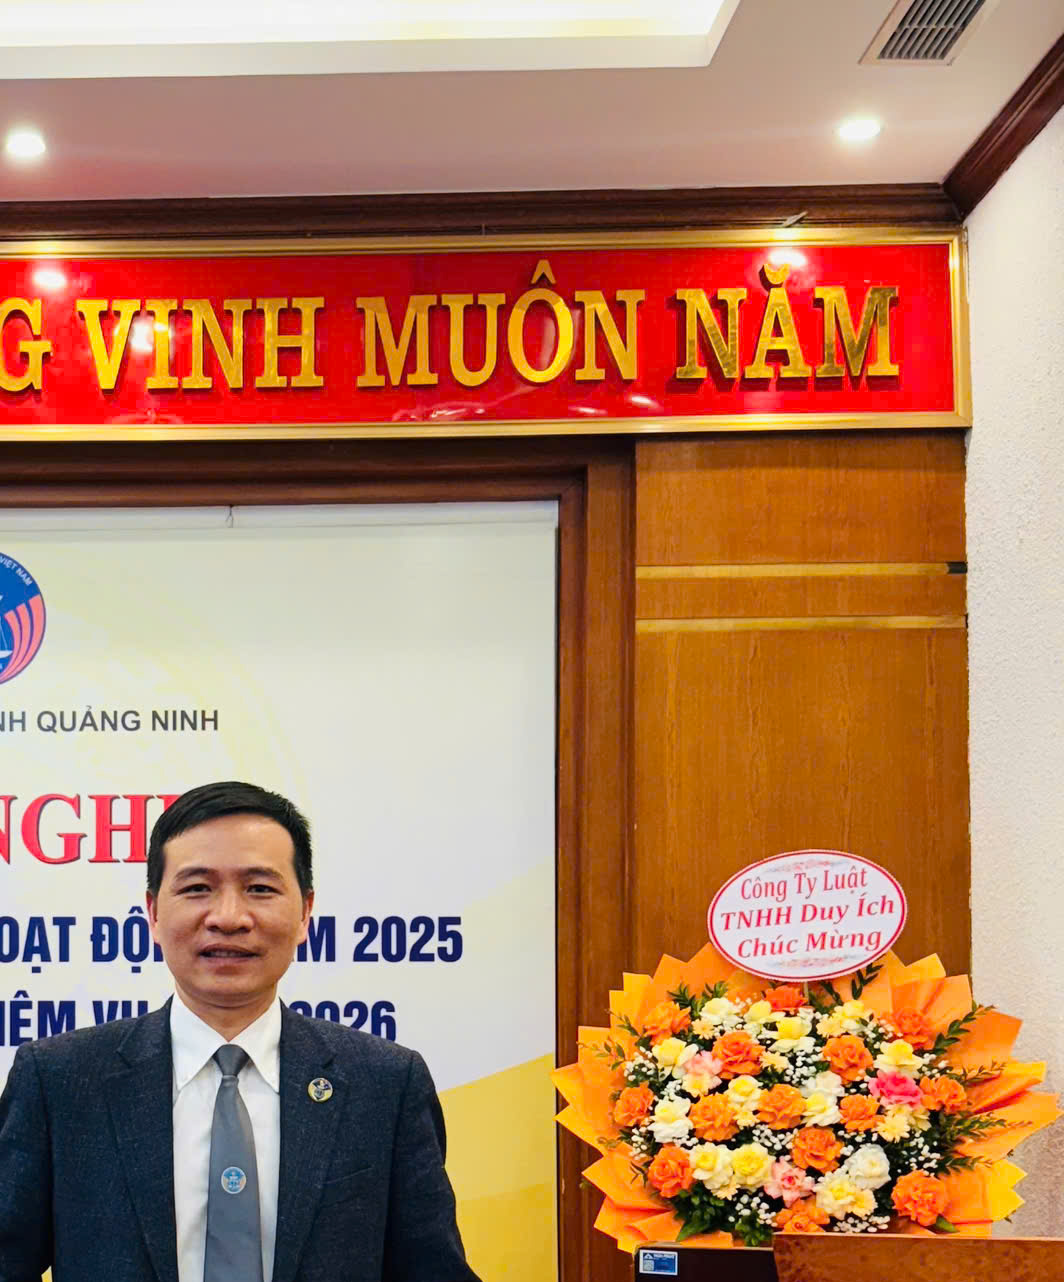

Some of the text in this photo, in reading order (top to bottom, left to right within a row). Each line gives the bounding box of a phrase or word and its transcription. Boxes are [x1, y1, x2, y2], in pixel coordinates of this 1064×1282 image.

[76, 296, 325, 391] VINH
[357, 259, 647, 386] MUÔN
[676, 263, 900, 381] NĂM
[15, 565, 33, 587] NAM
[37, 705, 141, 733] QUẢNG
[151, 710, 219, 731] NINH
[740, 866, 869, 902] Công Ty Luật
[720, 892, 895, 931] TNHH Duy Ích
[352, 915, 464, 963] 2025
[737, 928, 882, 959] Chúc Mừng
